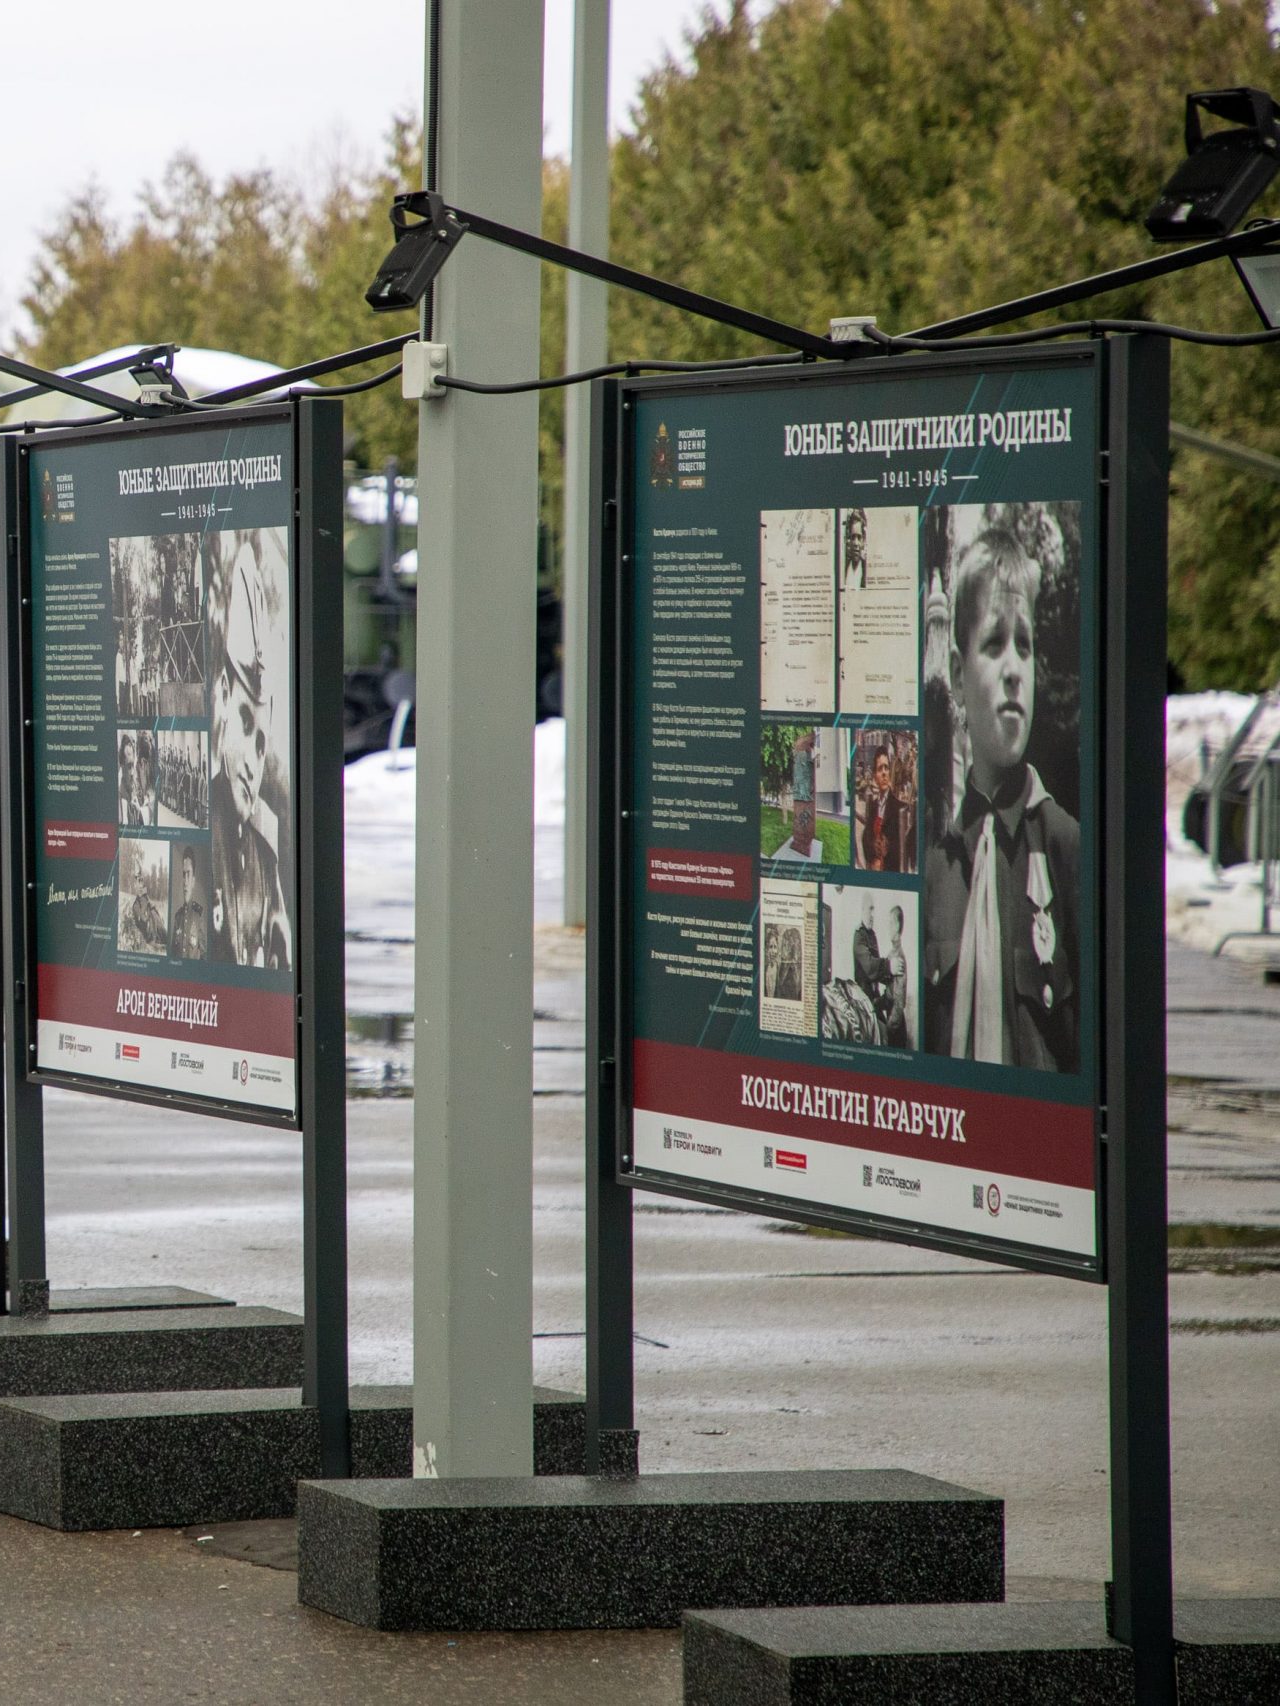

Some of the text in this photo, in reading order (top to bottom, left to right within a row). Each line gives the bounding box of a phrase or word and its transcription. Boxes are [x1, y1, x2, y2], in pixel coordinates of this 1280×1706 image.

[678, 439, 706, 450] ВОЕННО
[784, 408, 1072, 458] ЮНЫЕ ЗАЩИТНИКИ РОДИНЫ
[118, 454, 282, 495] ЮНЫЕ ЗАЩИТНИКИ РОДИНЫ
[882, 469, 948, 488] 1941-1945
[177, 503, 216, 519] 1941-1945
[116, 988, 219, 1030] АРОН ВЕРНИЦКИЙ
[741, 1074, 966, 1143] КОНСТАНТИН КРАВЧУК
[673, 1139, 690, 1151] ГЕРОИ
[696, 1144, 722, 1157] ПОДВИГИ
